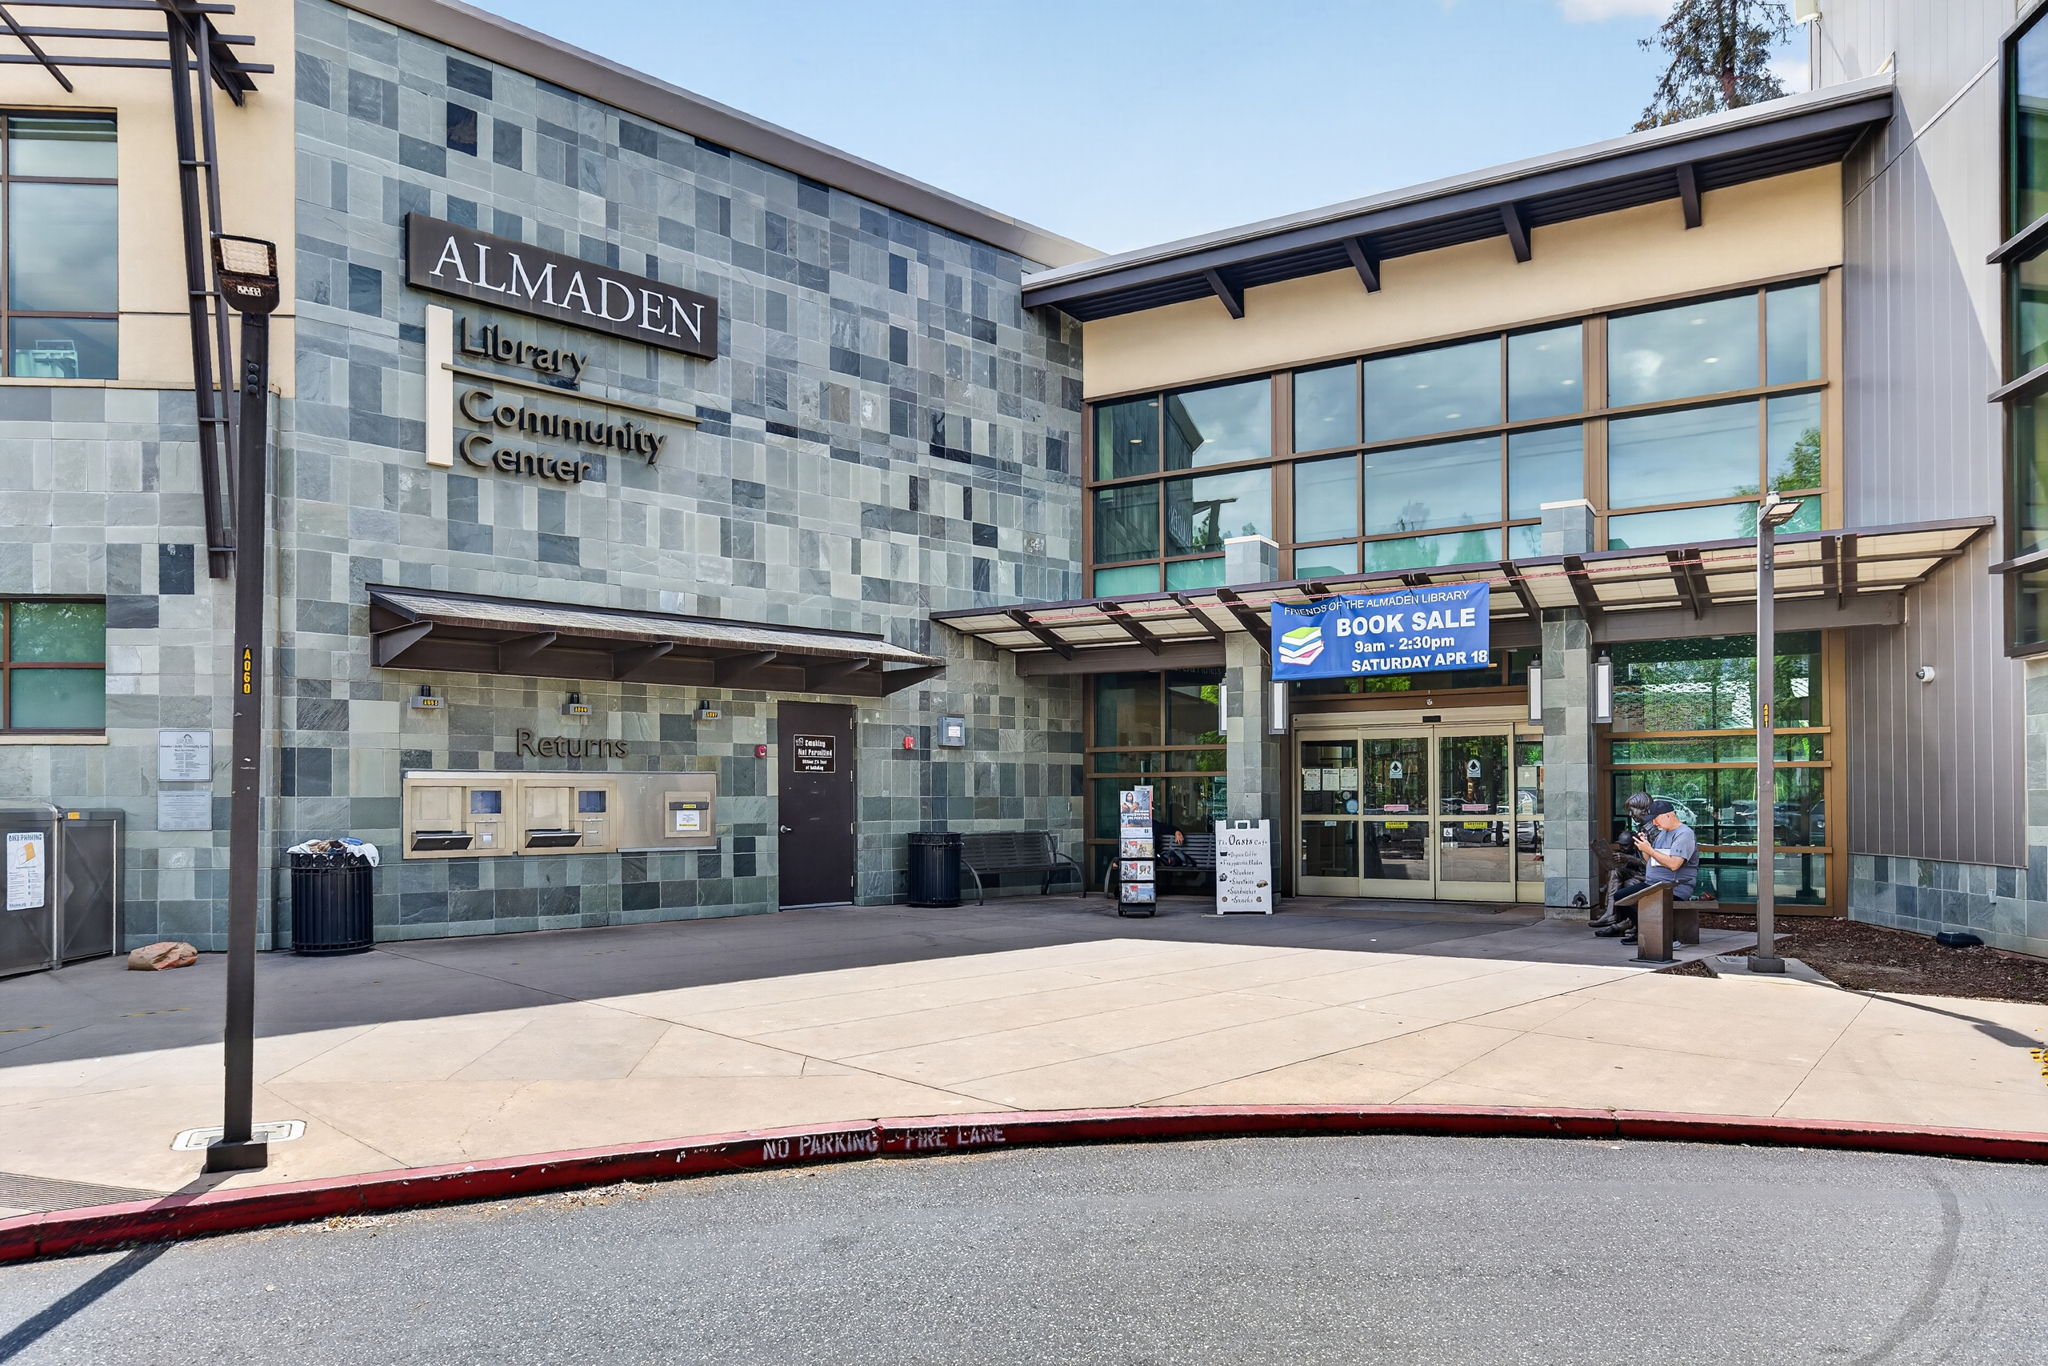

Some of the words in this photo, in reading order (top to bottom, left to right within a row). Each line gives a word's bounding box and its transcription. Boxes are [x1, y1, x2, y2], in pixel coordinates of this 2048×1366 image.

[429, 235, 705, 343] ALMADEN
[461, 317, 590, 385] Library
[459, 388, 668, 465] Community
[459, 432, 592, 483] Center
[1284, 604, 1327, 617] FRIENDS
[1328, 601, 1343, 612] OF
[1345, 599, 1365, 610] THE
[1366, 594, 1419, 609] ALMADEN
[1421, 590, 1470, 604] LIBRARY
[1336, 613, 1405, 637] BOOK
[1411, 607, 1476, 630] SALE
[1355, 640, 1385, 653] 9am
[1399, 635, 1455, 651] 2:30pm
[243, 648, 251, 694] A060
[1351, 655, 1431, 672] SATURDAY
[1435, 652, 1467, 667] APR
[1470, 650, 1488, 664] 18
[516, 728, 629, 758] Returns
[1229, 834, 1253, 846] Oasis
[762, 1138, 790, 1161] NO
[799, 1131, 881, 1156] PARKING
[904, 1127, 949, 1150] FIRE
[957, 1125, 1006, 1145] LANE
